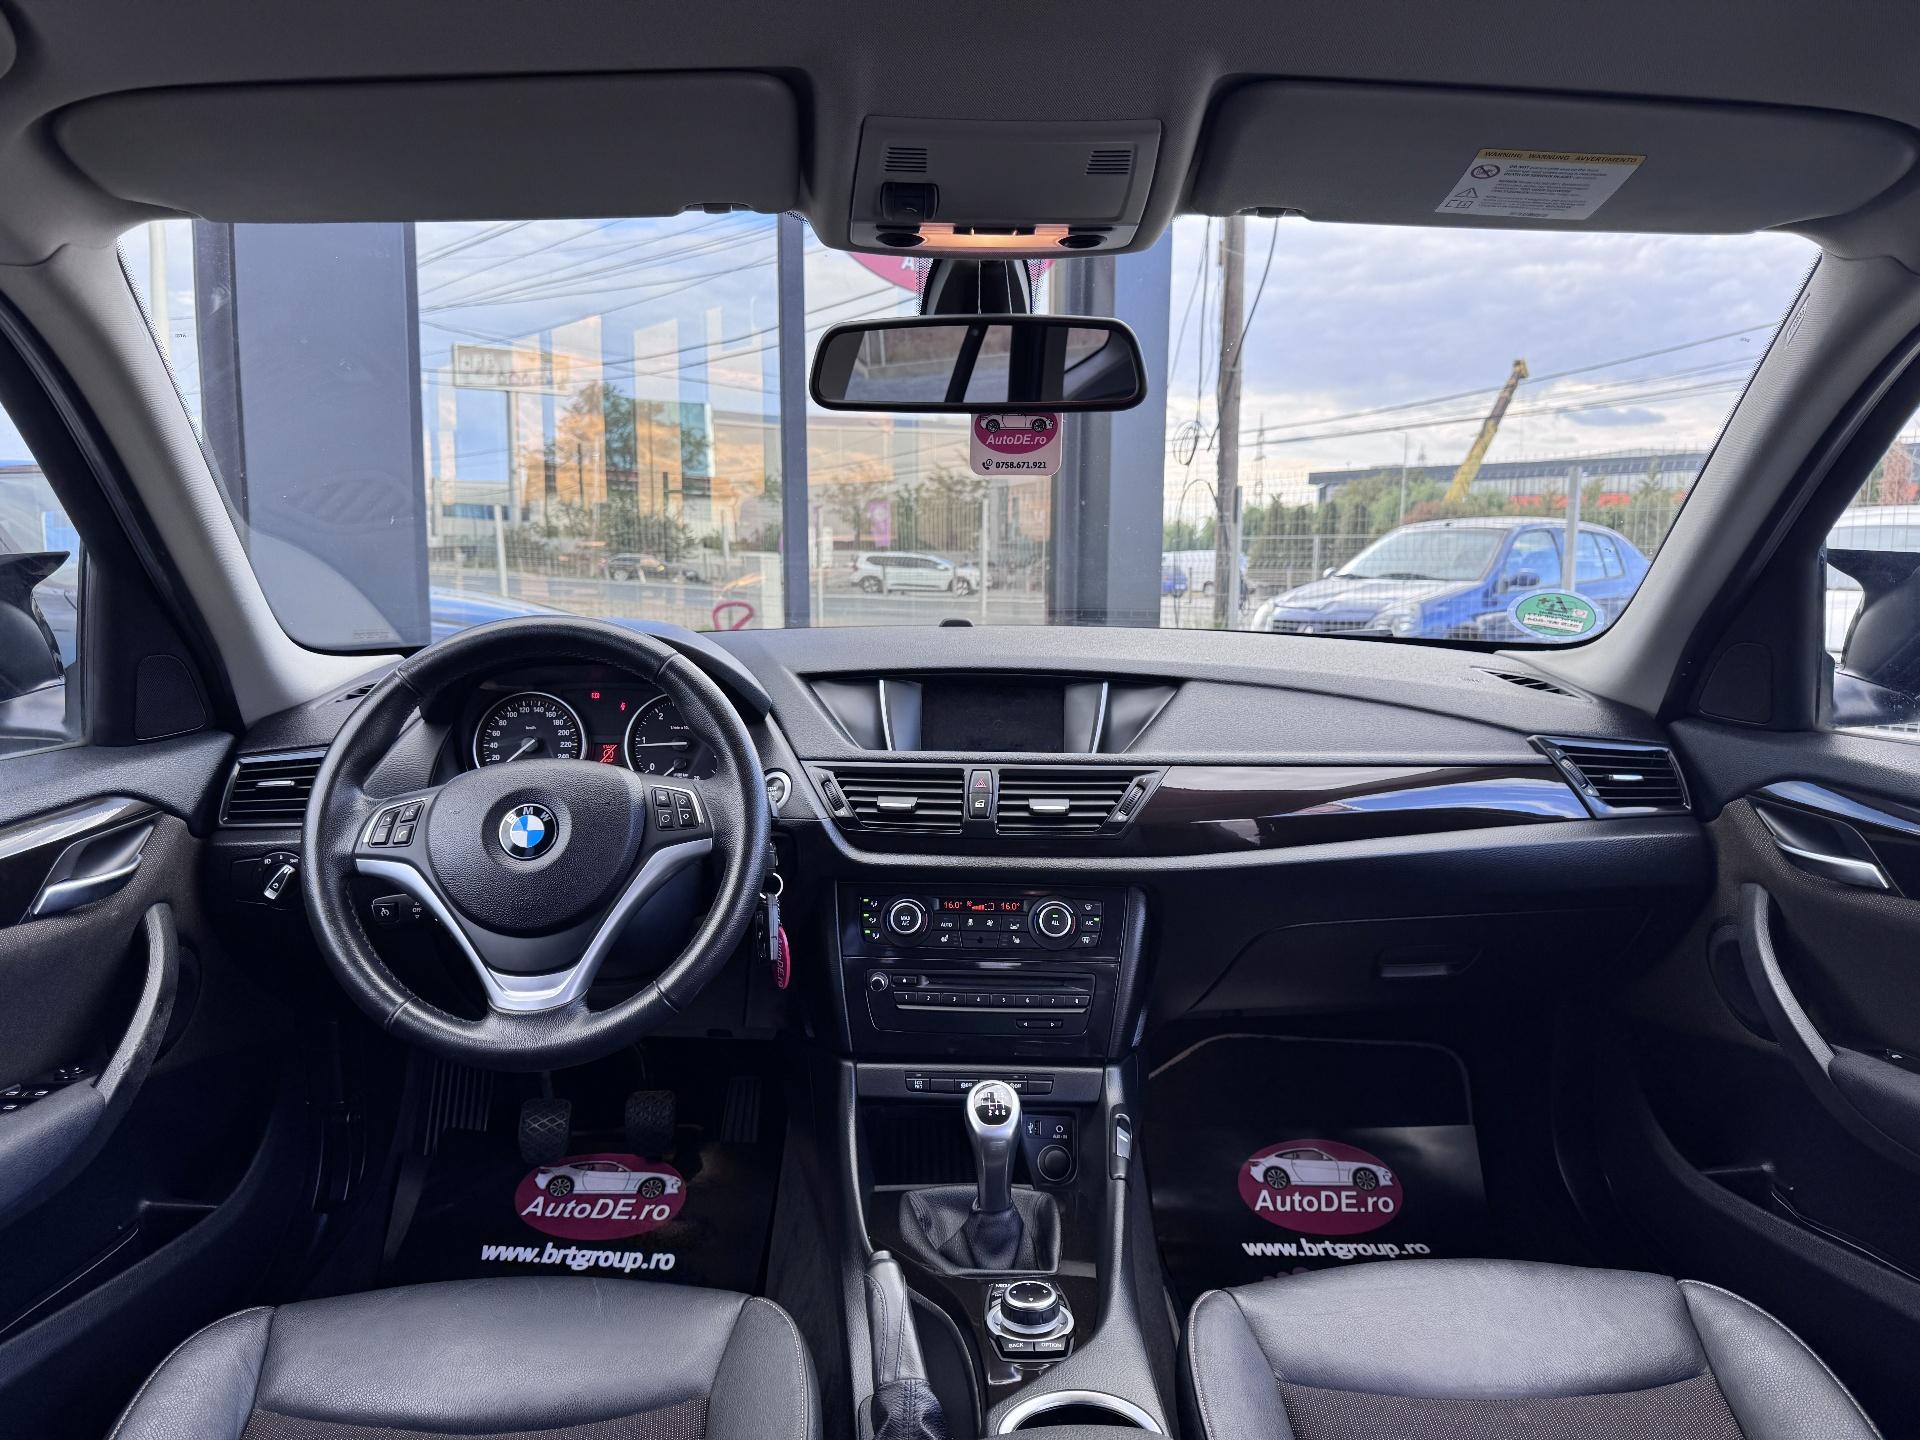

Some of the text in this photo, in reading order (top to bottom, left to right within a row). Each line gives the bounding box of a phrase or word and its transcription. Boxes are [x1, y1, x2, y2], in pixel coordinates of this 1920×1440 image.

[1484, 151, 1522, 159] WARNING
[986, 434, 1047, 445] AutoDE.ro
[995, 461, 1047, 469] 0758.671.921
[658, 712, 664, 720] 2
[521, 1195, 671, 1221] AutoDE.ro
[1254, 1189, 1394, 1213] AutoDE.ro
[481, 1241, 675, 1273] www.brtgroup.ro
[1241, 1237, 1431, 1260] www.brtgroup.ro
